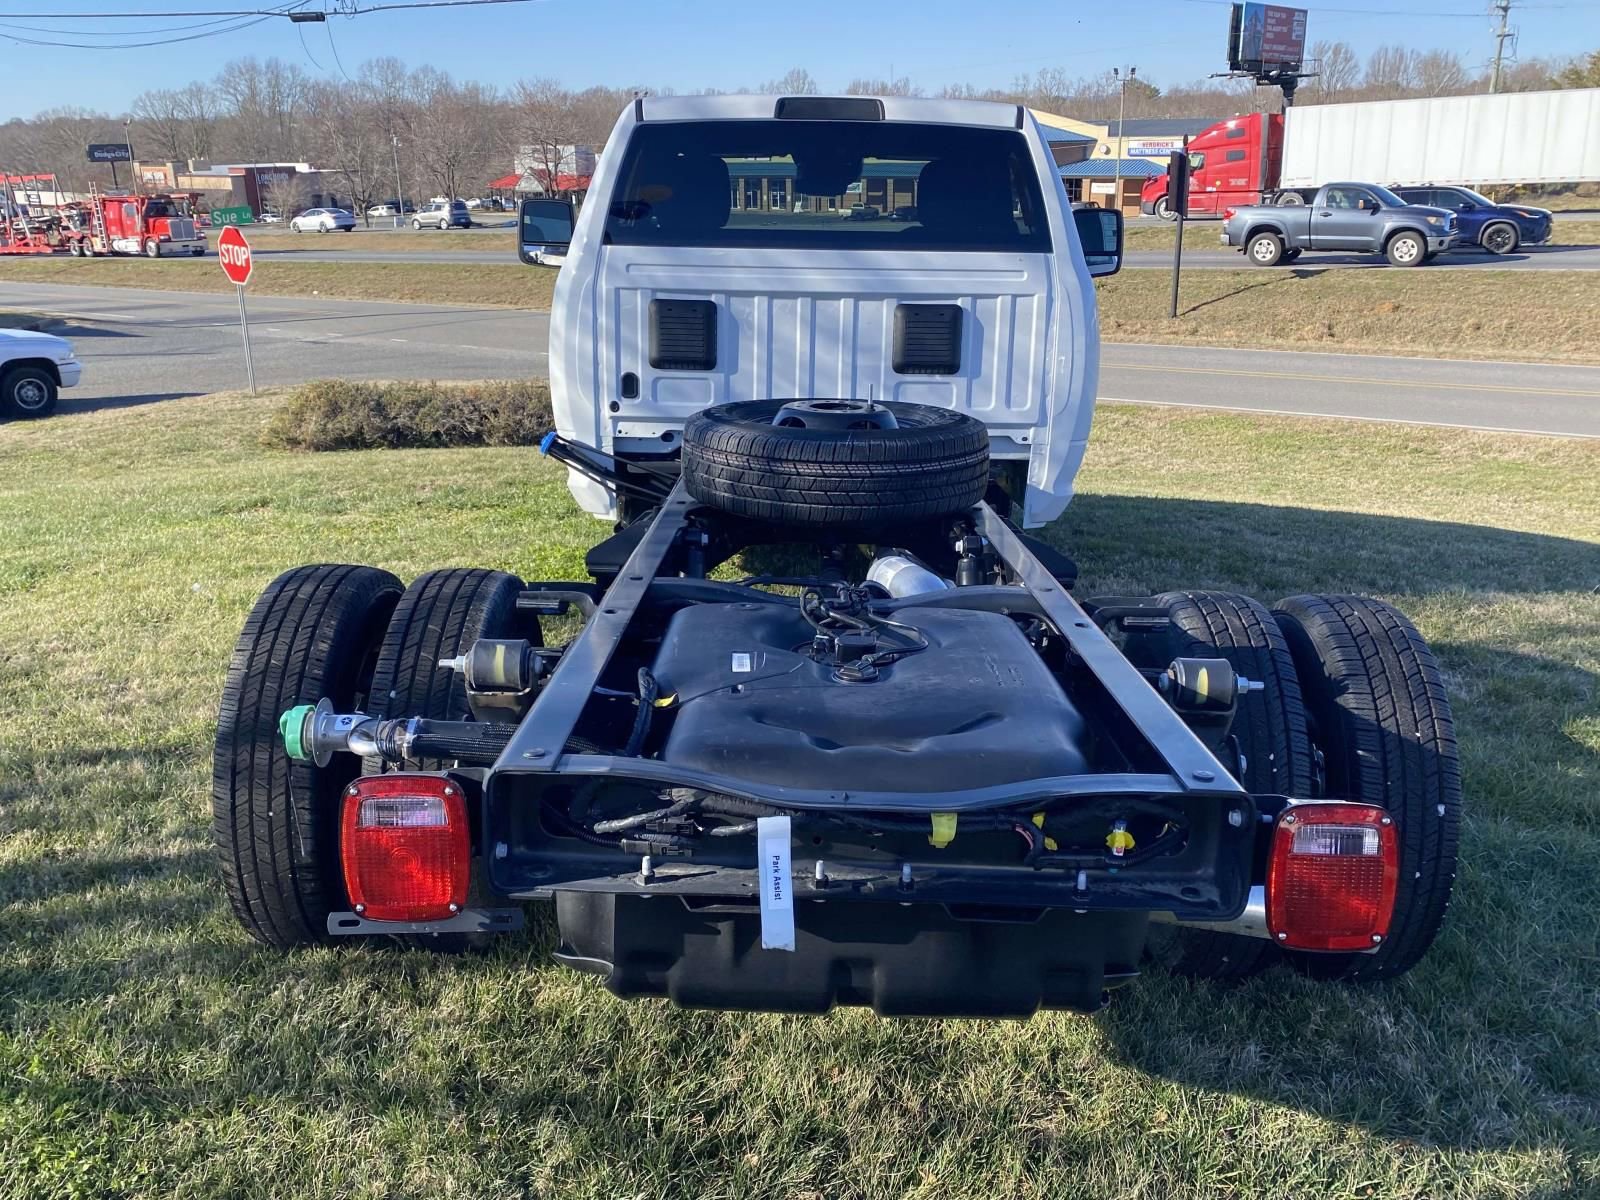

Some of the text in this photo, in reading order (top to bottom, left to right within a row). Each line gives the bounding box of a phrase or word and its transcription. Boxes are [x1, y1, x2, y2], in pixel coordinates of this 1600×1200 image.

[213, 211, 237, 225] Sue
[221, 244, 248, 267] STOP
[773, 855, 782, 901] Park Assist
